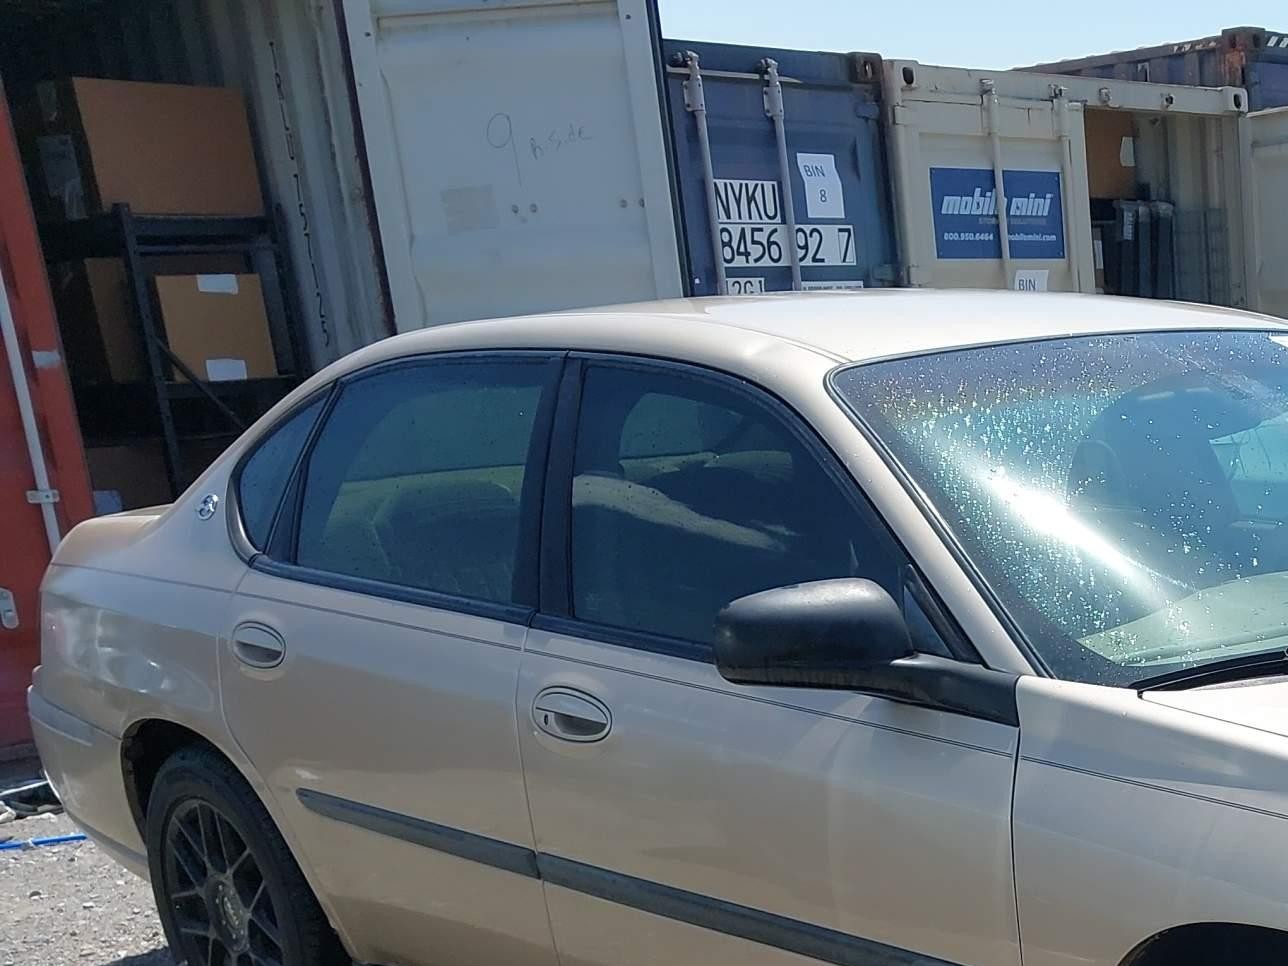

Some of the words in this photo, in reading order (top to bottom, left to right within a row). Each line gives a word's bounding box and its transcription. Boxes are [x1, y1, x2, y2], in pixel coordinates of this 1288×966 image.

[803, 164, 826, 178] BIN
[714, 181, 779, 221] NYKU
[819, 188, 828, 203] 8
[941, 187, 1008, 215] mobil
[1009, 192, 1054, 217] mini
[1018, 278, 1037, 291] BIN
